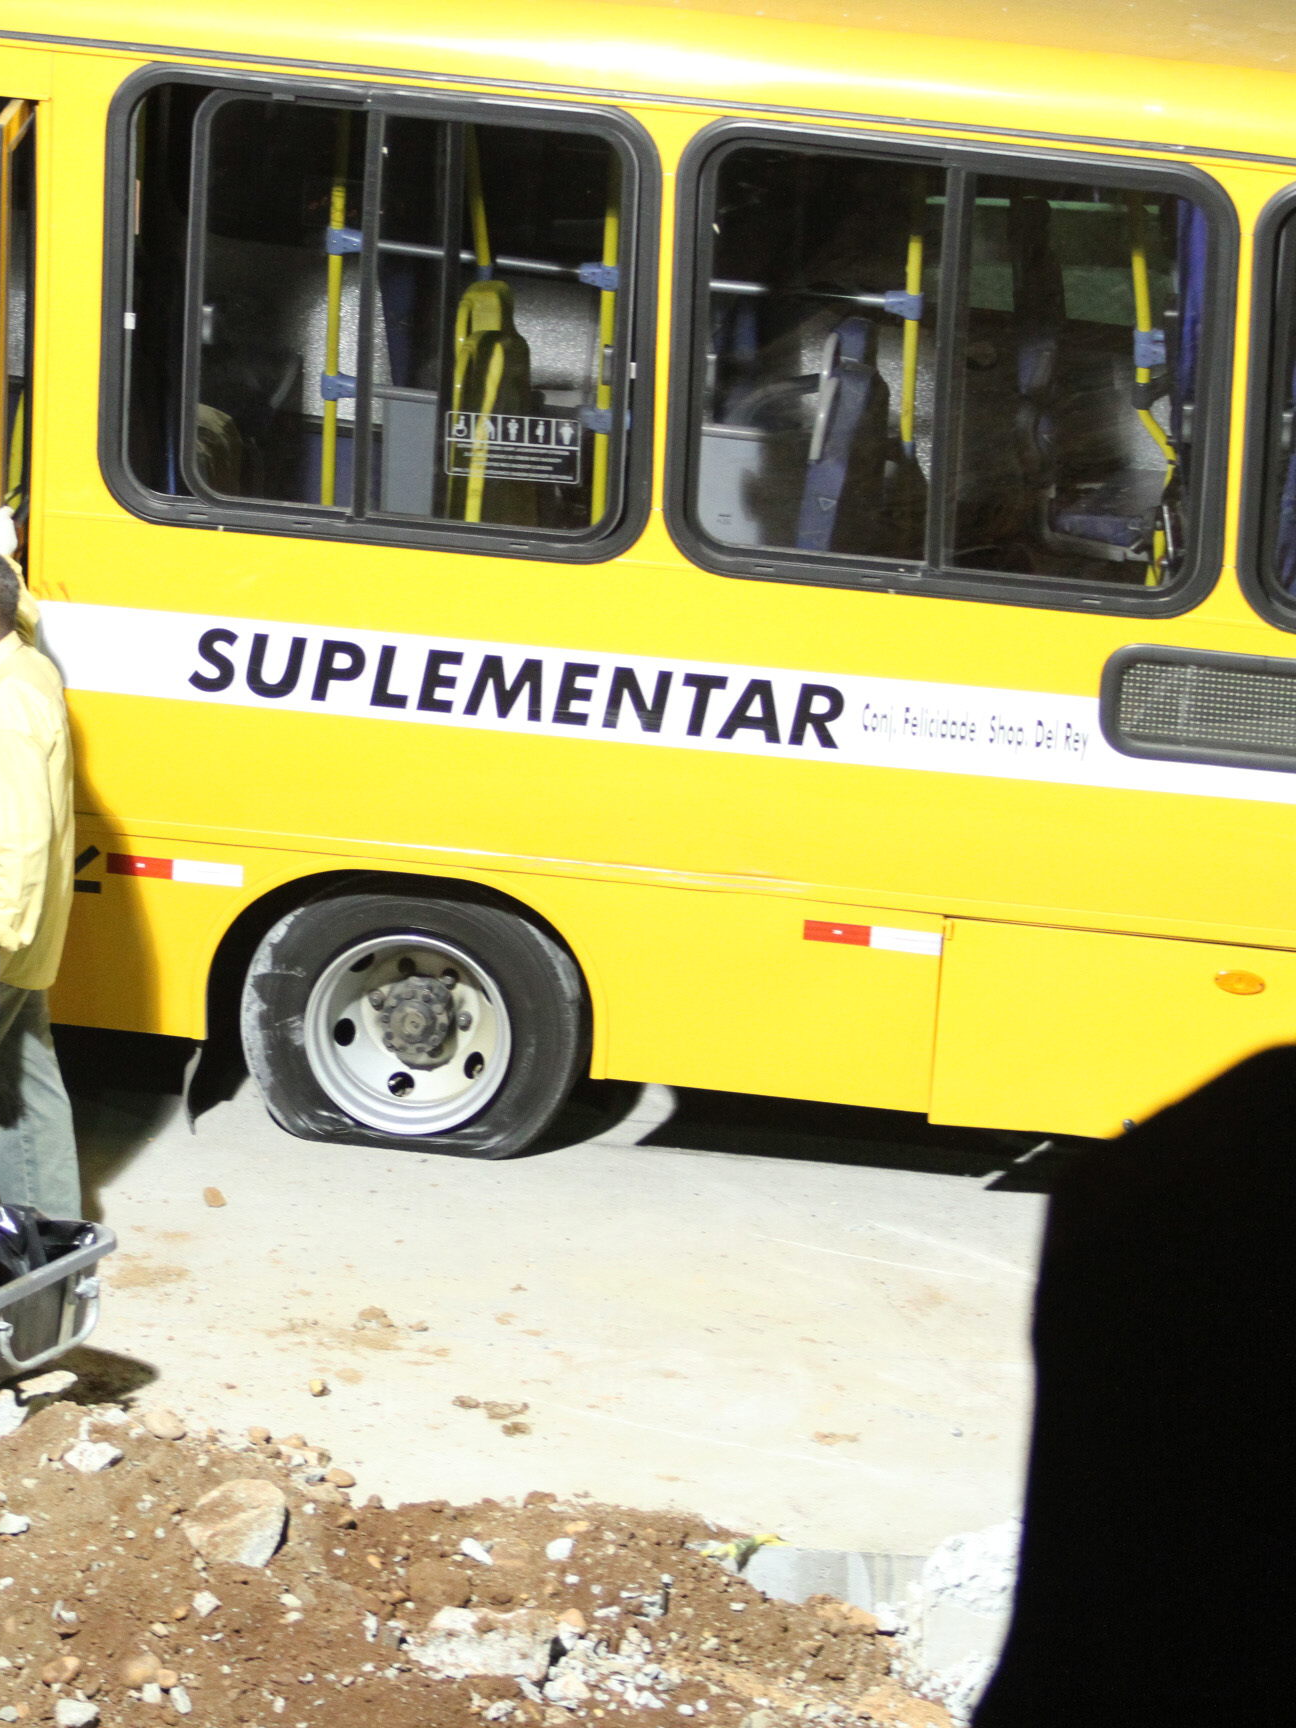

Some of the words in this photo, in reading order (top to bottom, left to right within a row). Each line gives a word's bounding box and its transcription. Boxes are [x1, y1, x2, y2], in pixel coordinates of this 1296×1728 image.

[187, 627, 846, 750] SUPLEMENTAR
[861, 702, 897, 743] Conj.
[988, 714, 1028, 754] Shop.
[1034, 718, 1060, 750] Del
[1064, 721, 1089, 761] Rey
